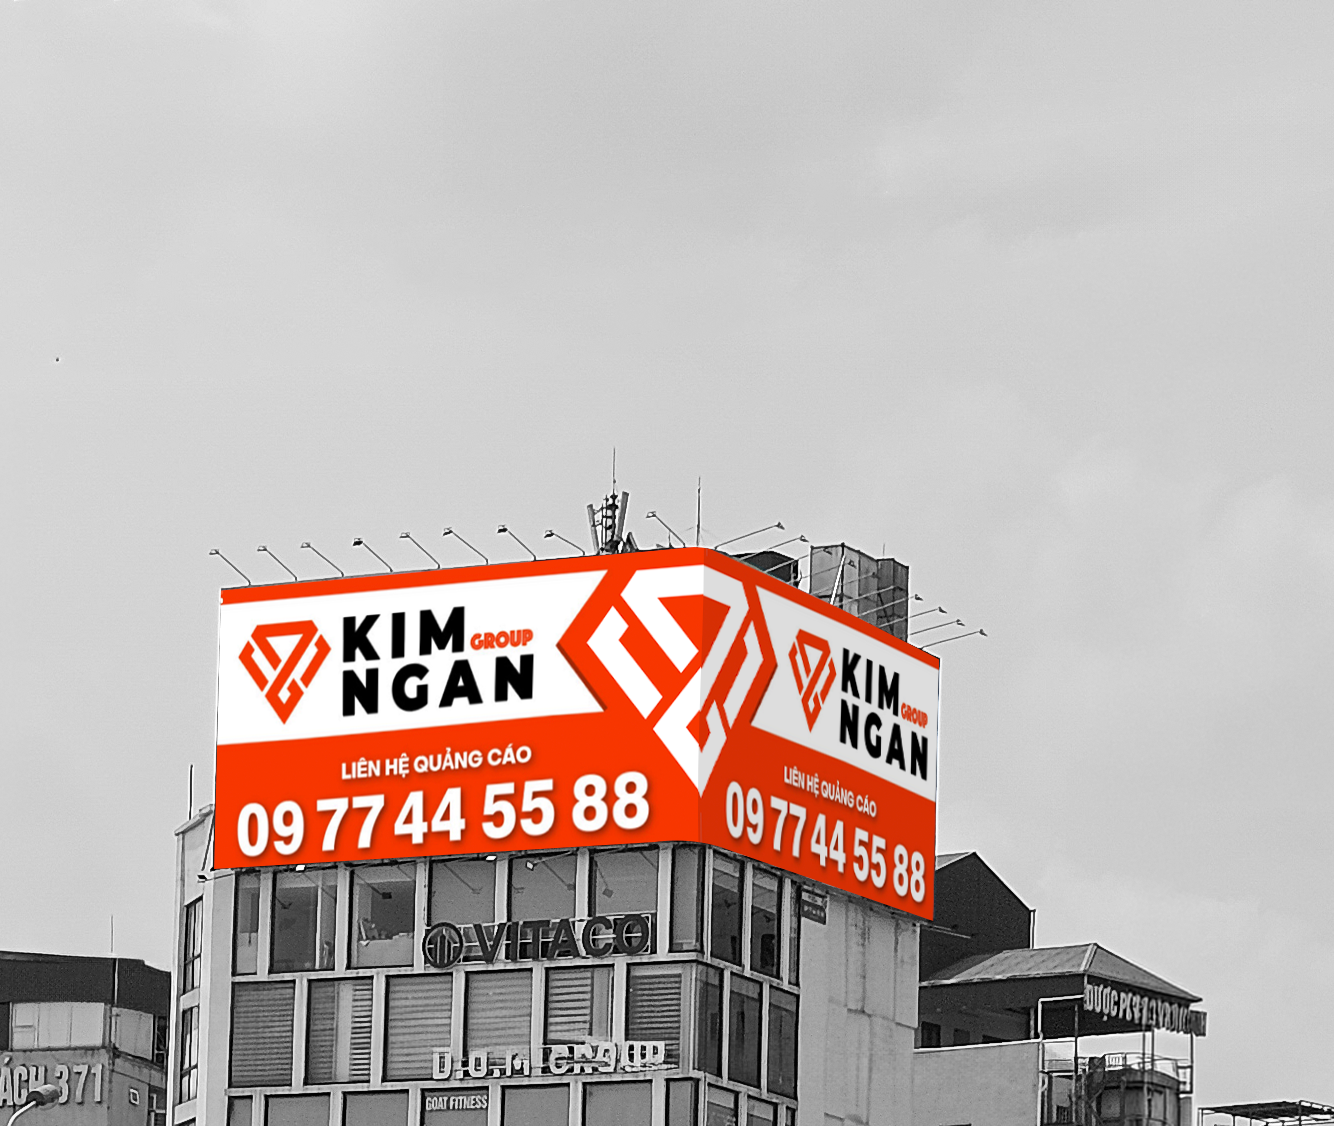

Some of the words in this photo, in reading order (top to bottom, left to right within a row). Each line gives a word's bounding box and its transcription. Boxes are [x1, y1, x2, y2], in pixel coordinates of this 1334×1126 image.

[343, 606, 465, 662] KIM
[470, 629, 533, 650] GROUP
[342, 654, 534, 717] NGAN
[841, 647, 900, 717] KIM
[901, 702, 928, 729] GROUP
[341, 758, 380, 780] LIÊN
[384, 753, 409, 779] HỆ
[414, 748, 483, 773] QUẢNG
[487, 744, 532, 766] CÁO
[839, 698, 928, 781] NGAN
[237, 800, 305, 857] 09
[316, 794, 385, 852] 77
[394, 787, 465, 845] 44
[482, 779, 555, 840] 55
[572, 772, 650, 832] 88
[784, 765, 805, 790] LIÊN
[806, 773, 819, 798] HỆ
[821, 780, 854, 808] QUẢNG
[856, 795, 877, 817] CÁO
[725, 781, 764, 845] 09
[770, 795, 807, 858] 77
[810, 813, 846, 874] 44
[853, 827, 887, 888] 55
[893, 844, 926, 903] 88
[473, 914, 649, 964] VITACO
[55, 1063, 103, 1104] 371
[426, 1096, 448, 1111] GOAT
[450, 1095, 488, 1110] FITNESS
